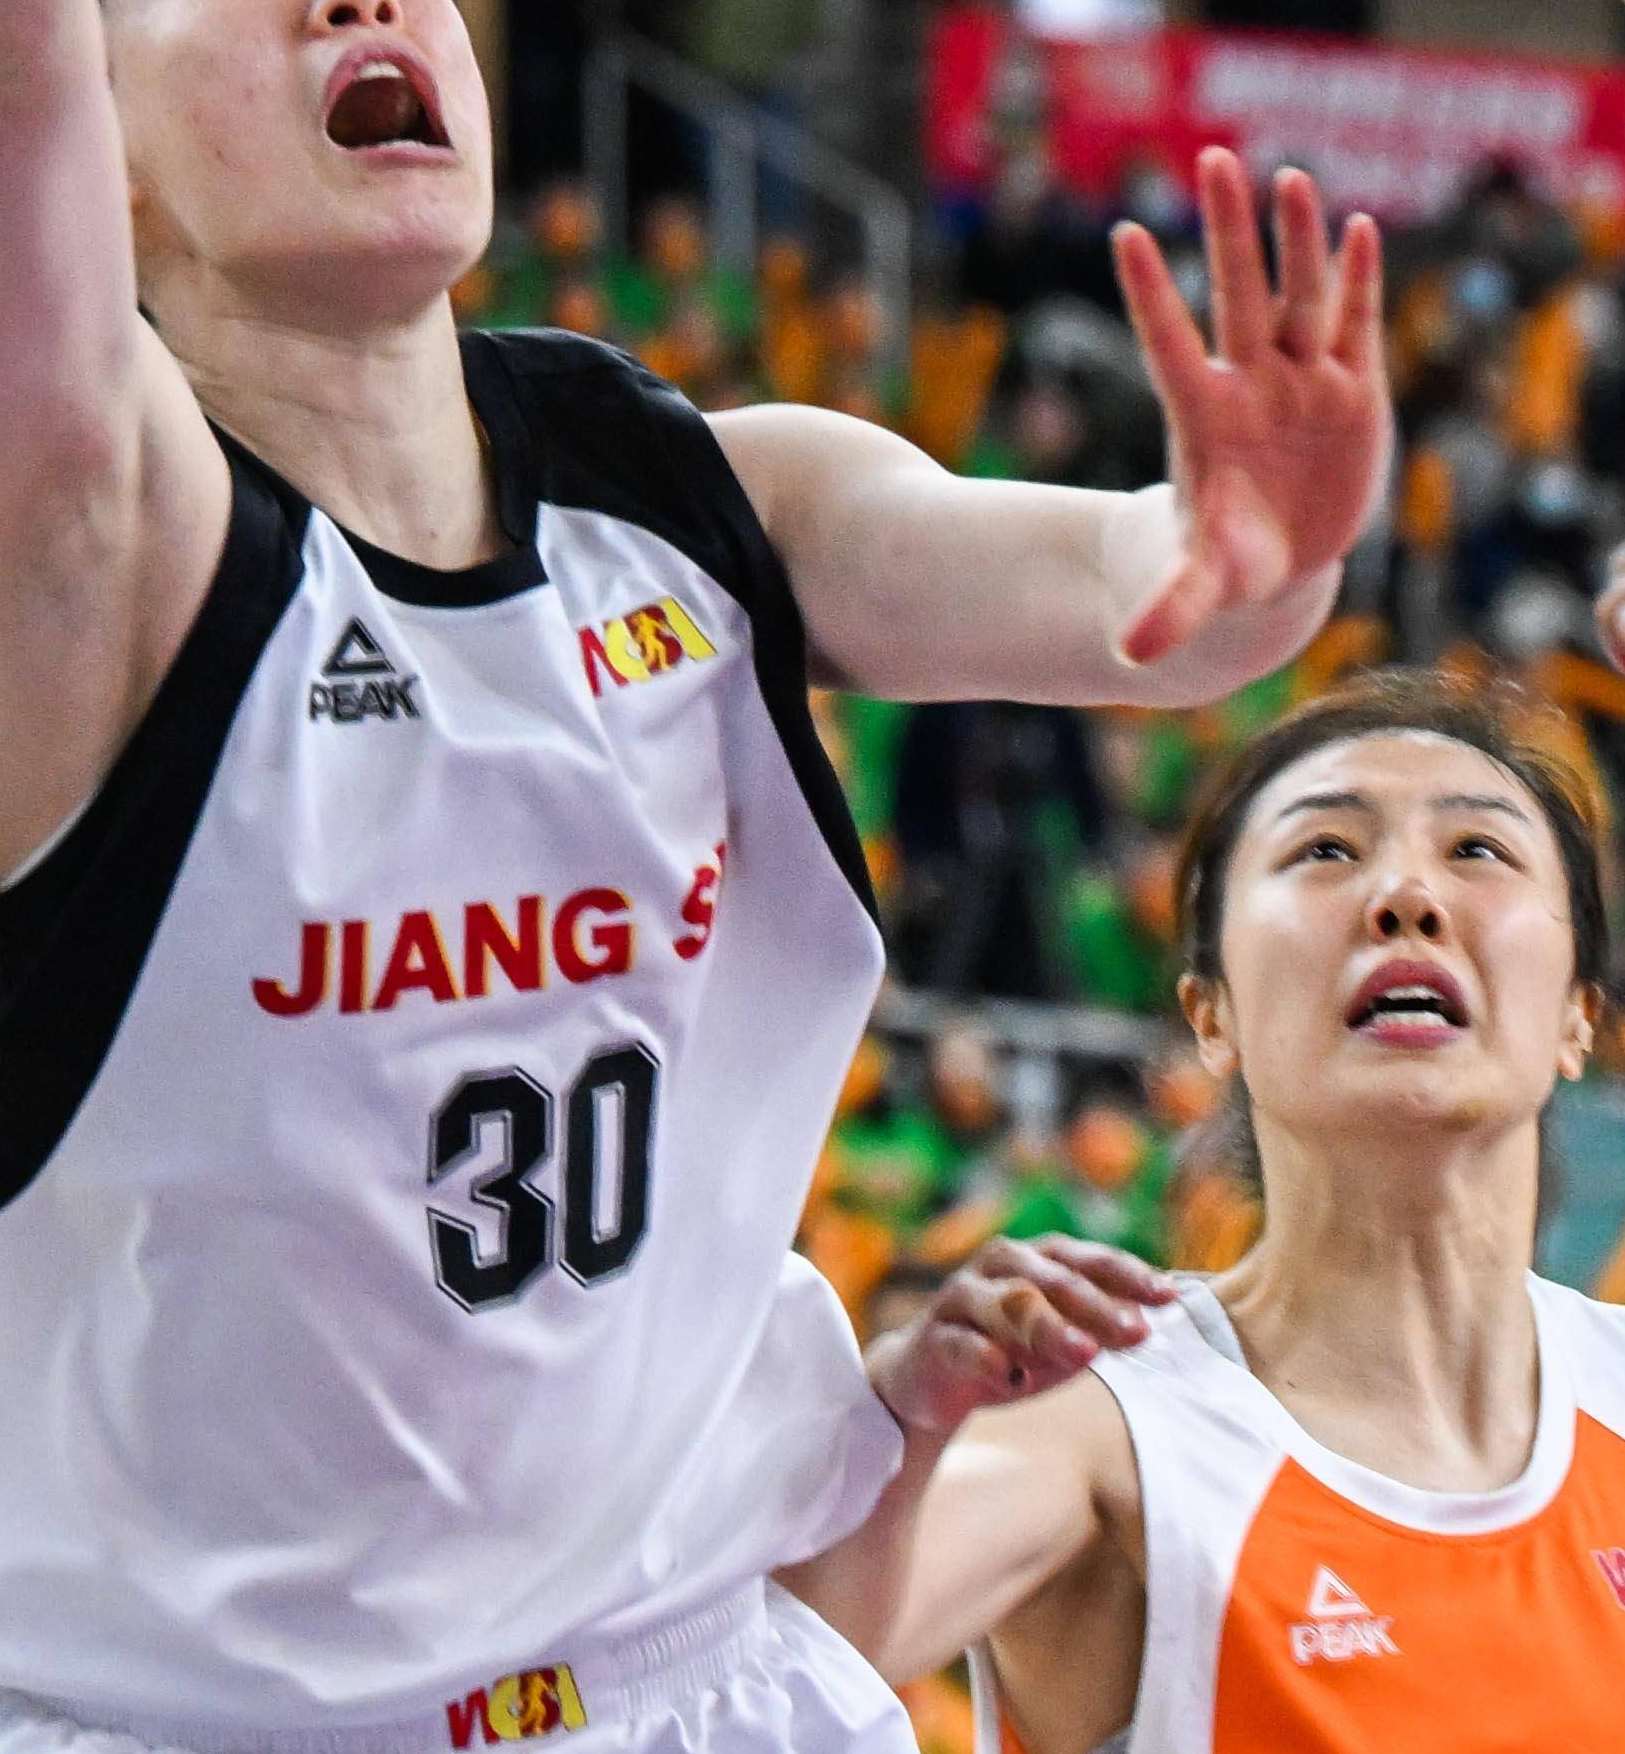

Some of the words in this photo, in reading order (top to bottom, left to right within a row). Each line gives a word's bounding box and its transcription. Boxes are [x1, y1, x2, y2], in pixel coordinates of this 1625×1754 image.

[310, 674, 420, 723] PEAK
[251, 887, 635, 1019] JIANG
[426, 1040, 661, 1315] 30
[1288, 1612, 1402, 1667] PEAK
